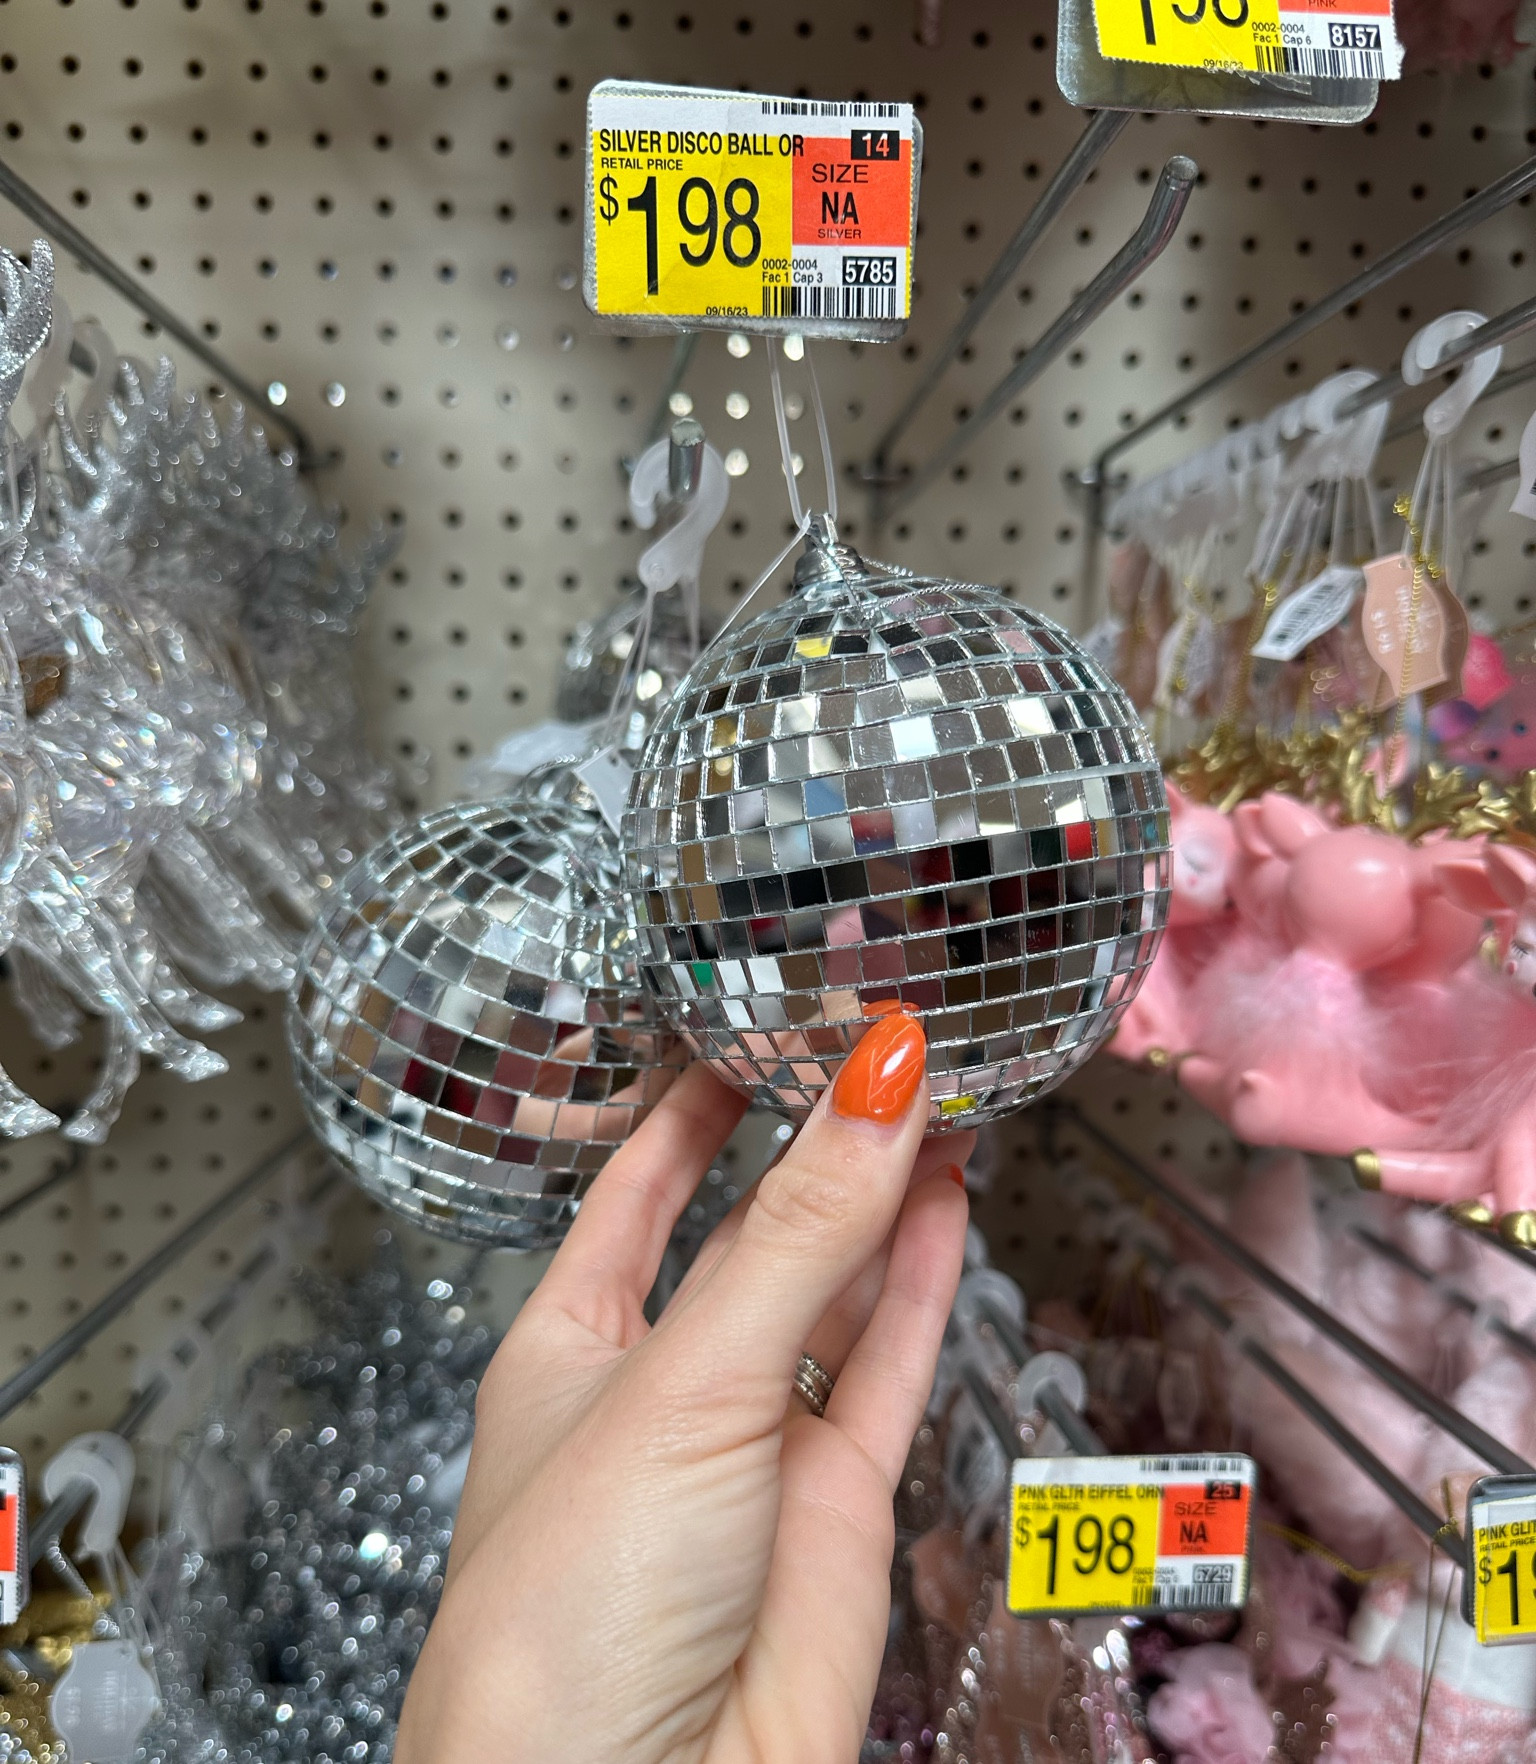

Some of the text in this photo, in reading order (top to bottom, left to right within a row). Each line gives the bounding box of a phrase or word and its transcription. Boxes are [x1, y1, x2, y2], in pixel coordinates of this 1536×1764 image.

[1251, 22, 1305, 33] 0002-0004
[1331, 25, 1378, 48] 8157
[1253, 33, 1272, 43] Fac
[1283, 35, 1303, 47] Cap
[1305, 36, 1312, 45] 6
[599, 128, 804, 157] SILVER DISCO BALL OR
[862, 132, 890, 157] 14
[601, 157, 683, 171] RETAIL PRICE
[812, 163, 869, 183] SIZE
[822, 191, 859, 225] NA
[817, 228, 862, 239] SILVER
[762, 258, 818, 270] 0002-0004
[844, 259, 894, 284] 5785
[762, 272, 781, 283] Fac
[793, 273, 814, 285] Cap
[816, 272, 823, 283] 3
[705, 306, 749, 316] 09/16/23
[1174, 1501, 1217, 1516] SIZE
[1180, 1520, 1208, 1543] NA
[1479, 1524, 1507, 1542] PINK
[1478, 1550, 1536, 1626] $1
